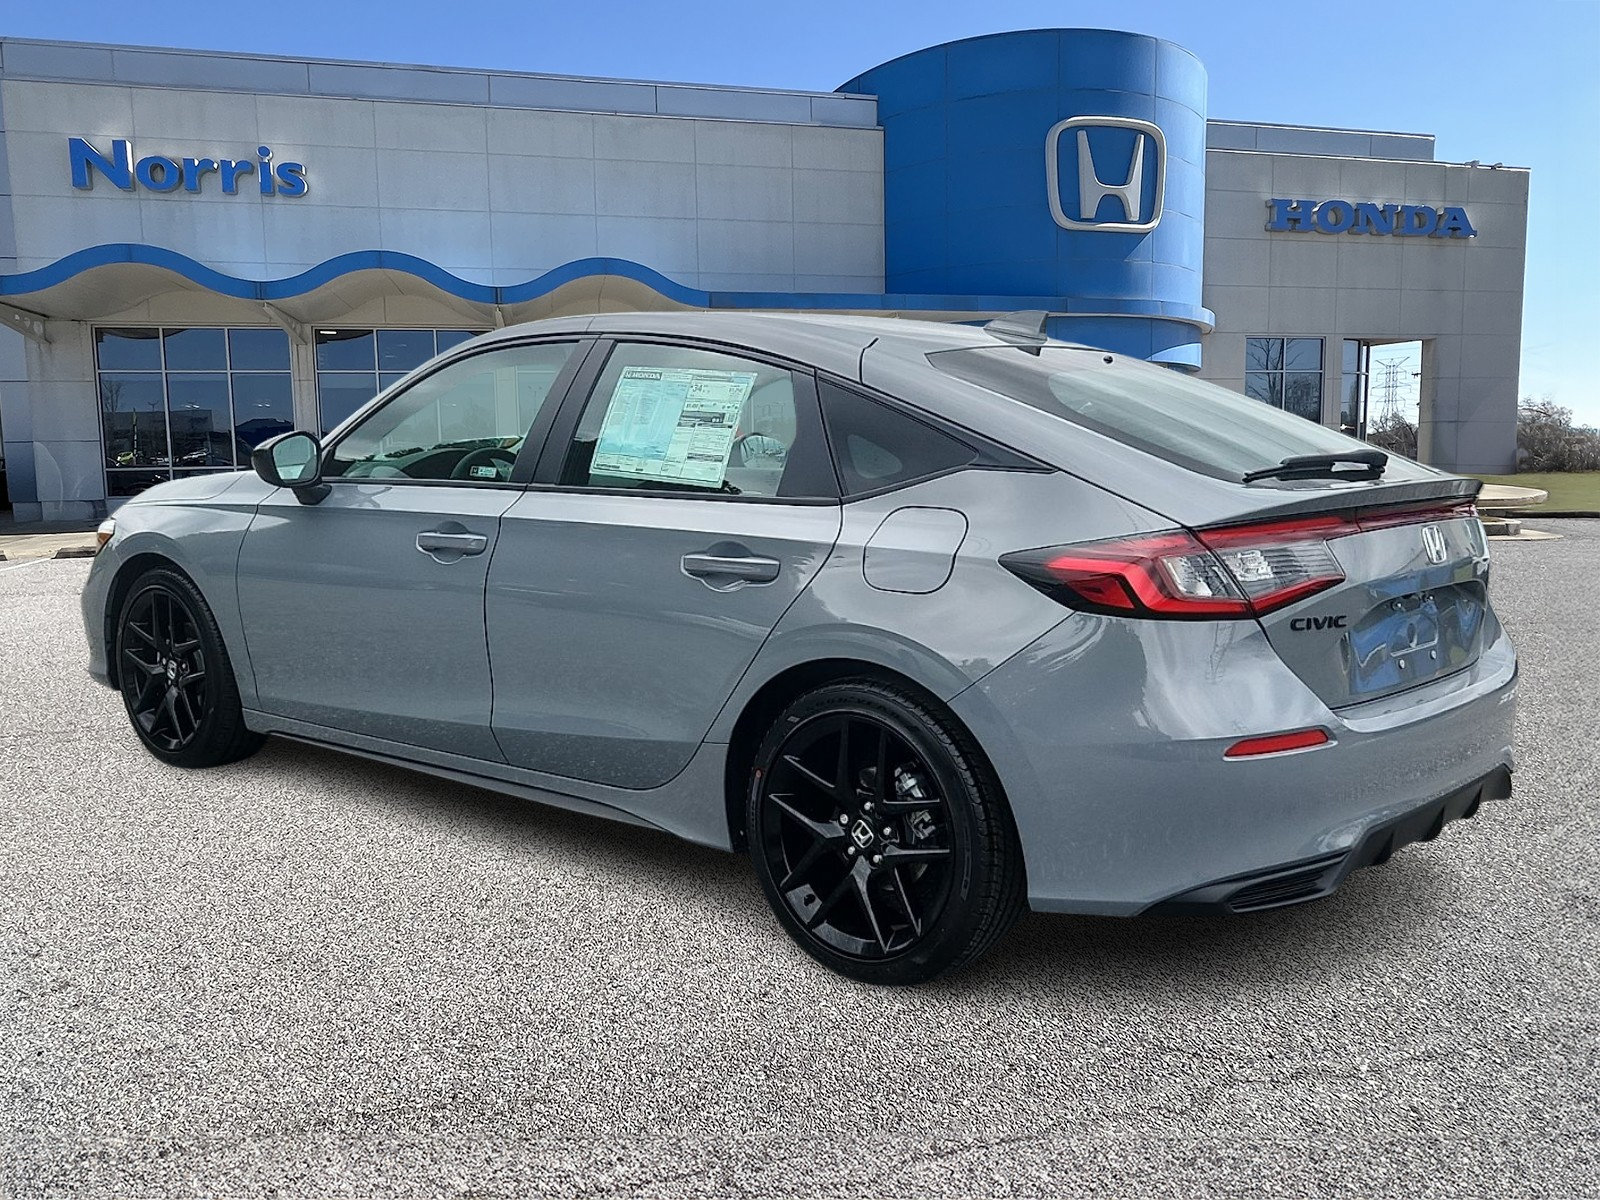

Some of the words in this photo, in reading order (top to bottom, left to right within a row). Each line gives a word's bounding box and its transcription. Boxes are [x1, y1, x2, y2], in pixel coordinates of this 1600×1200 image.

[68, 137, 309, 197] Norris
[1267, 198, 1478, 239] HONDA
[631, 371, 661, 380] HONDA
[1290, 615, 1347, 631] CIVIC
